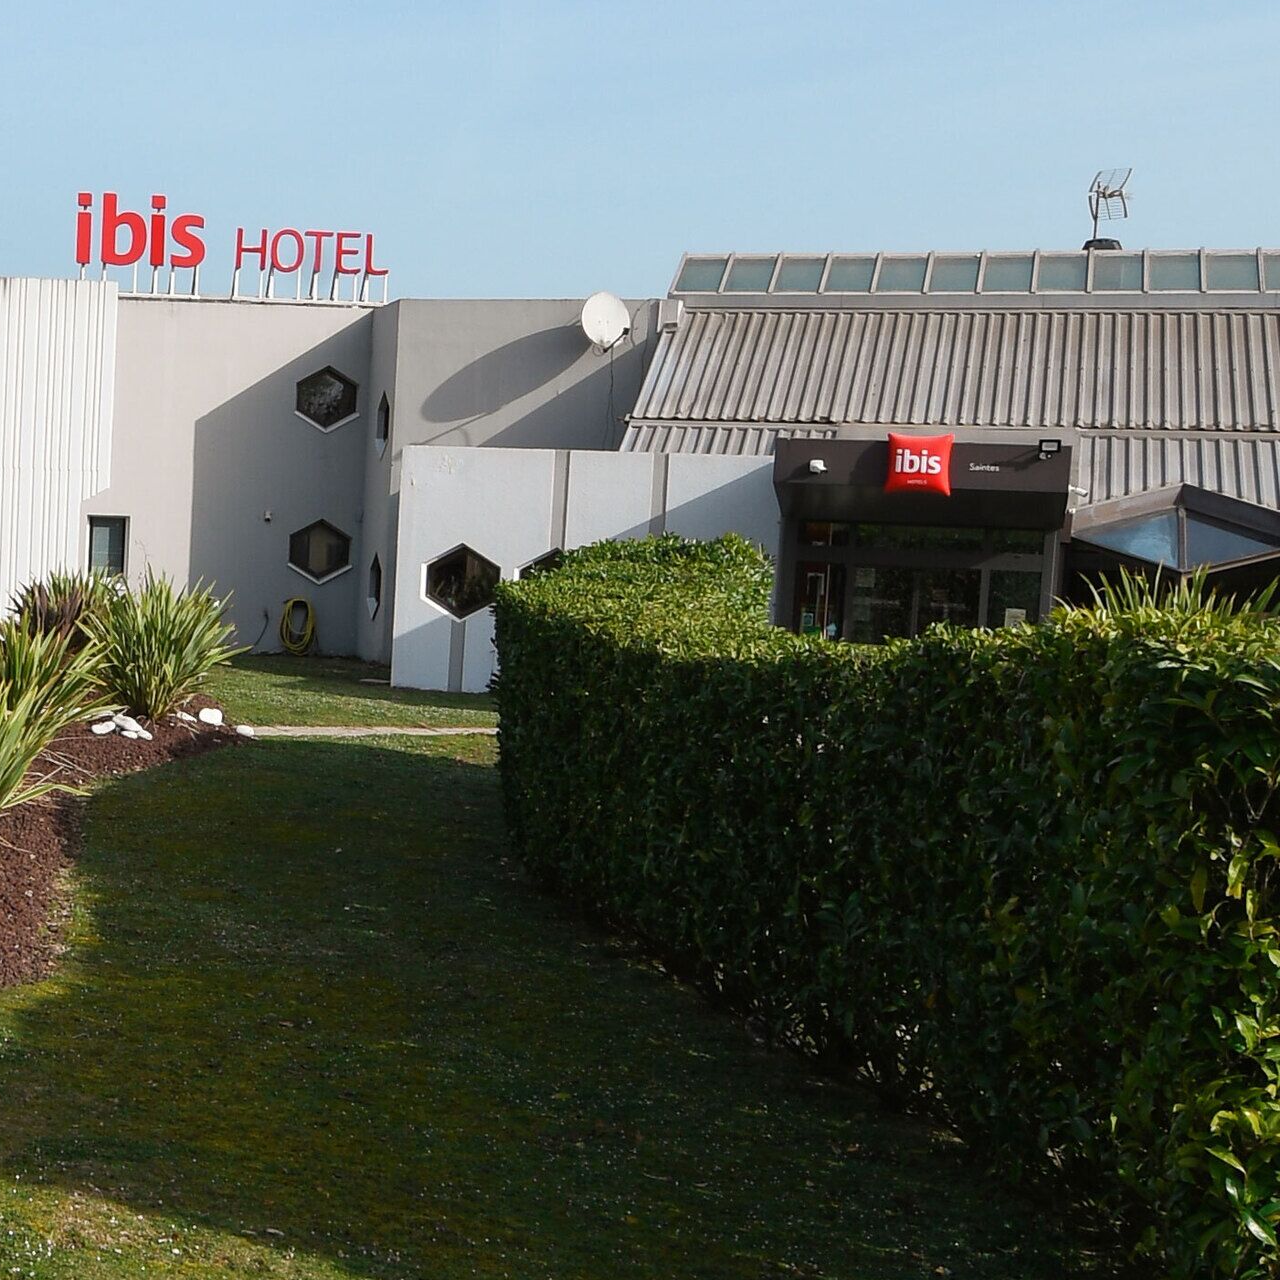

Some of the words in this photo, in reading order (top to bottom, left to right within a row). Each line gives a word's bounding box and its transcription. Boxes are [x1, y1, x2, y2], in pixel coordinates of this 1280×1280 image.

[76, 192, 206, 269] ibis
[235, 227, 389, 276] HOTEL
[895, 448, 942, 475] ibis
